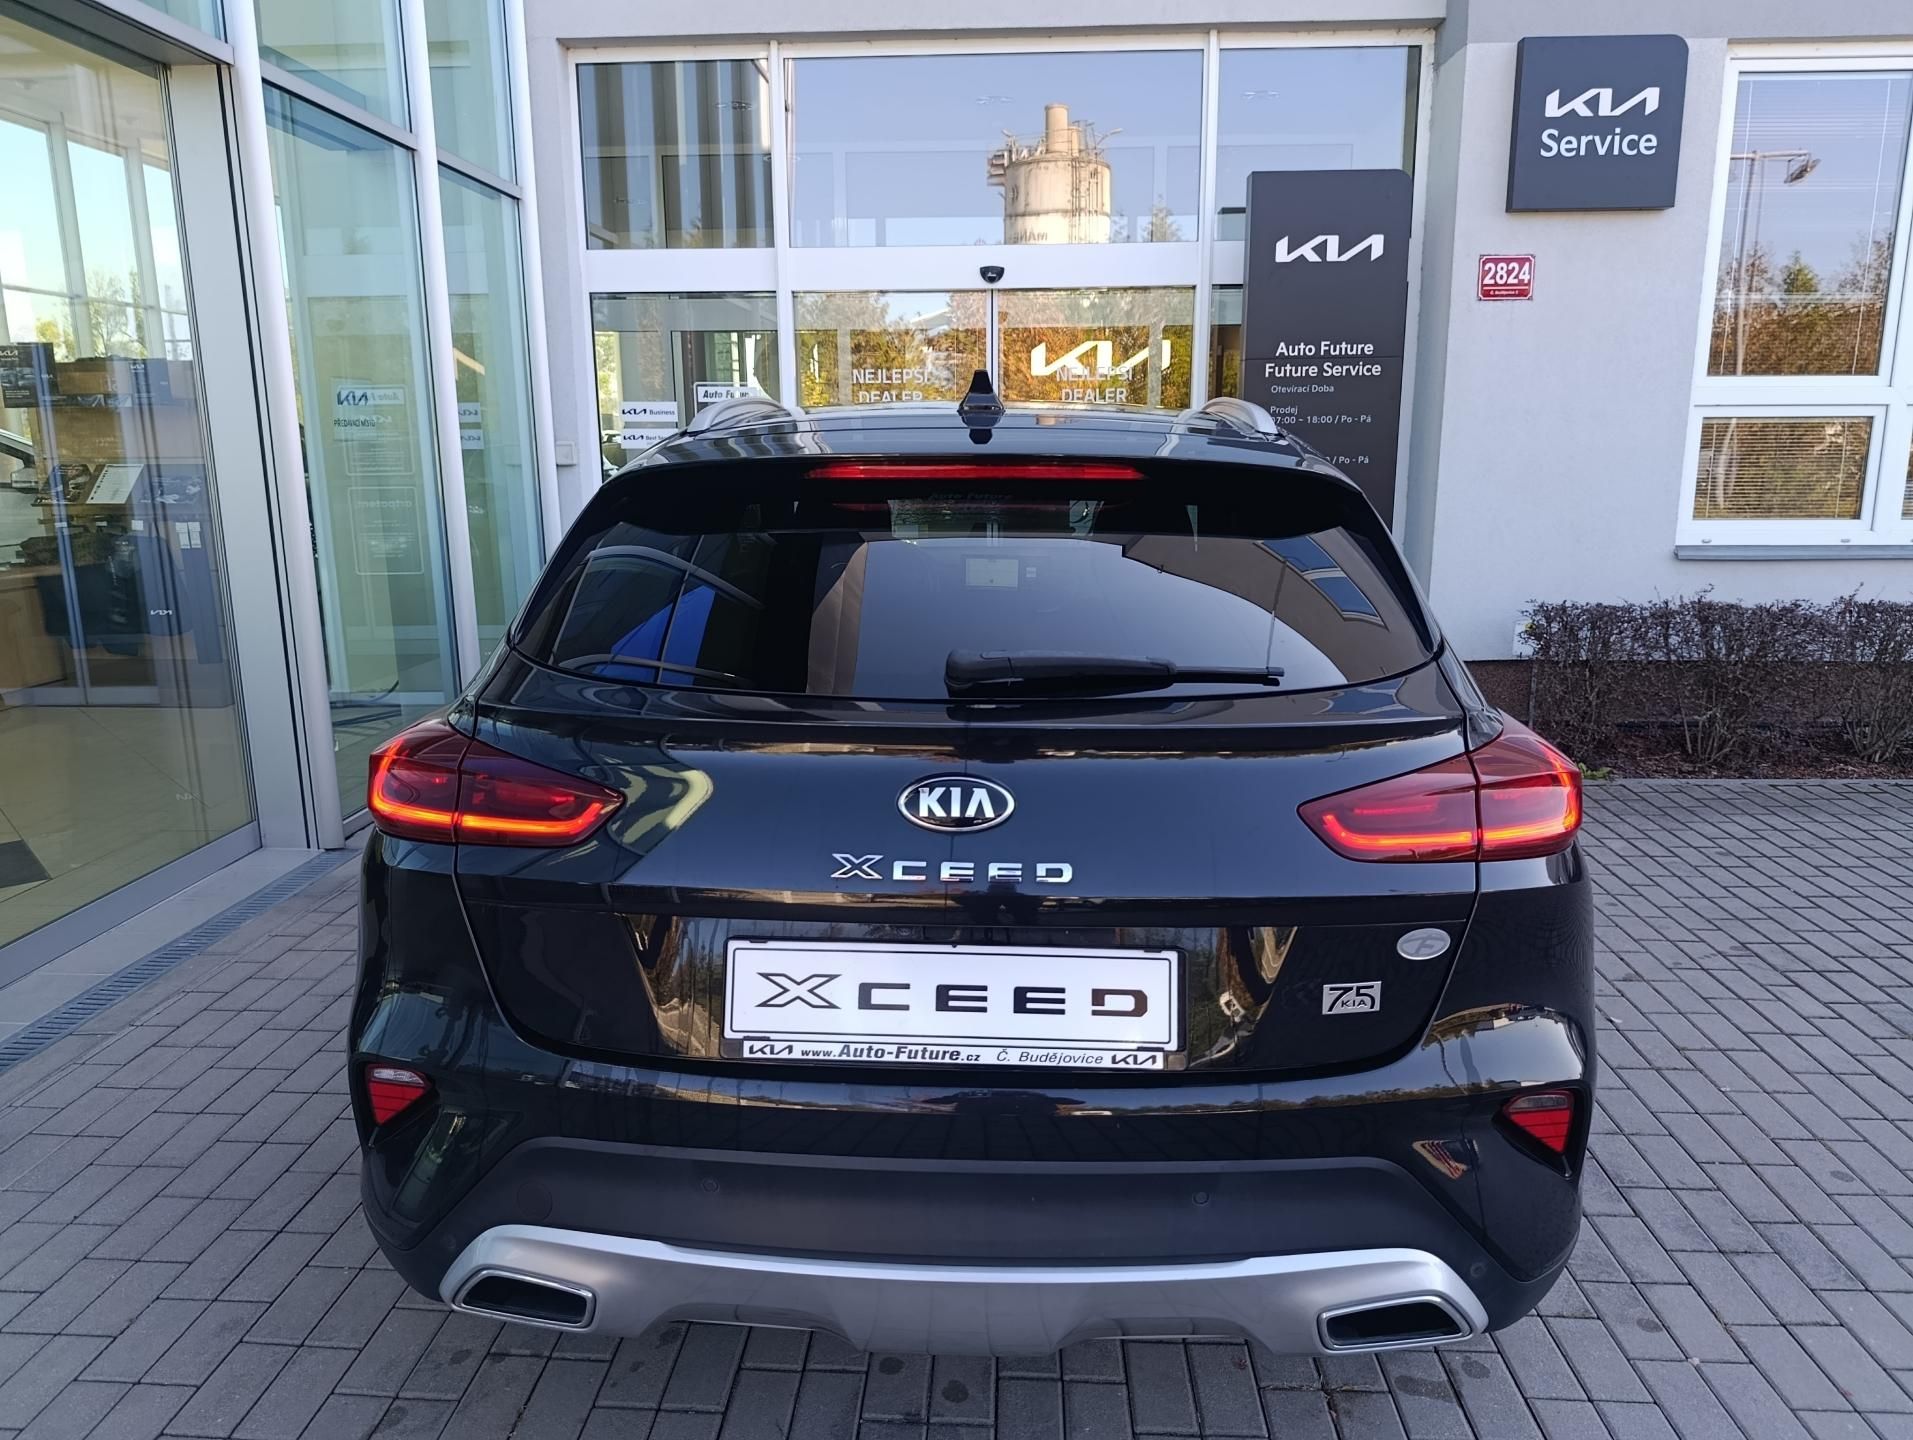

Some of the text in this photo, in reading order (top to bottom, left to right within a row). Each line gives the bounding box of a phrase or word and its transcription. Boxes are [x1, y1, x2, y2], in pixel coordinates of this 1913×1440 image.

[1545, 87, 1660, 117] KIA
[1540, 127, 1658, 157] Service
[1275, 234, 1385, 263] KIA
[1483, 262, 1531, 285] 2824
[1276, 341, 1374, 357] Auto Future
[1265, 361, 1382, 378] Future Service
[703, 390, 723, 398] Auto
[1061, 388, 1127, 403] DEALER
[1312, 384, 1334, 393] Doba
[1270, 405, 1298, 415] Prodej
[1341, 415, 1352, 423] Po
[1360, 414, 1372, 423] Pá
[1339, 456, 1350, 464] Po
[1358, 455, 1369, 464] Pá
[919, 787, 995, 818] KIA
[830, 853, 1073, 883] XCEED
[755, 971, 1148, 1018] XCEED
[1327, 985, 1376, 1012] 75
[1341, 999, 1368, 1008] KIA
[749, 1043, 1157, 1066] KIA www.Auto-Future.cz Č. Budějovice KIA
